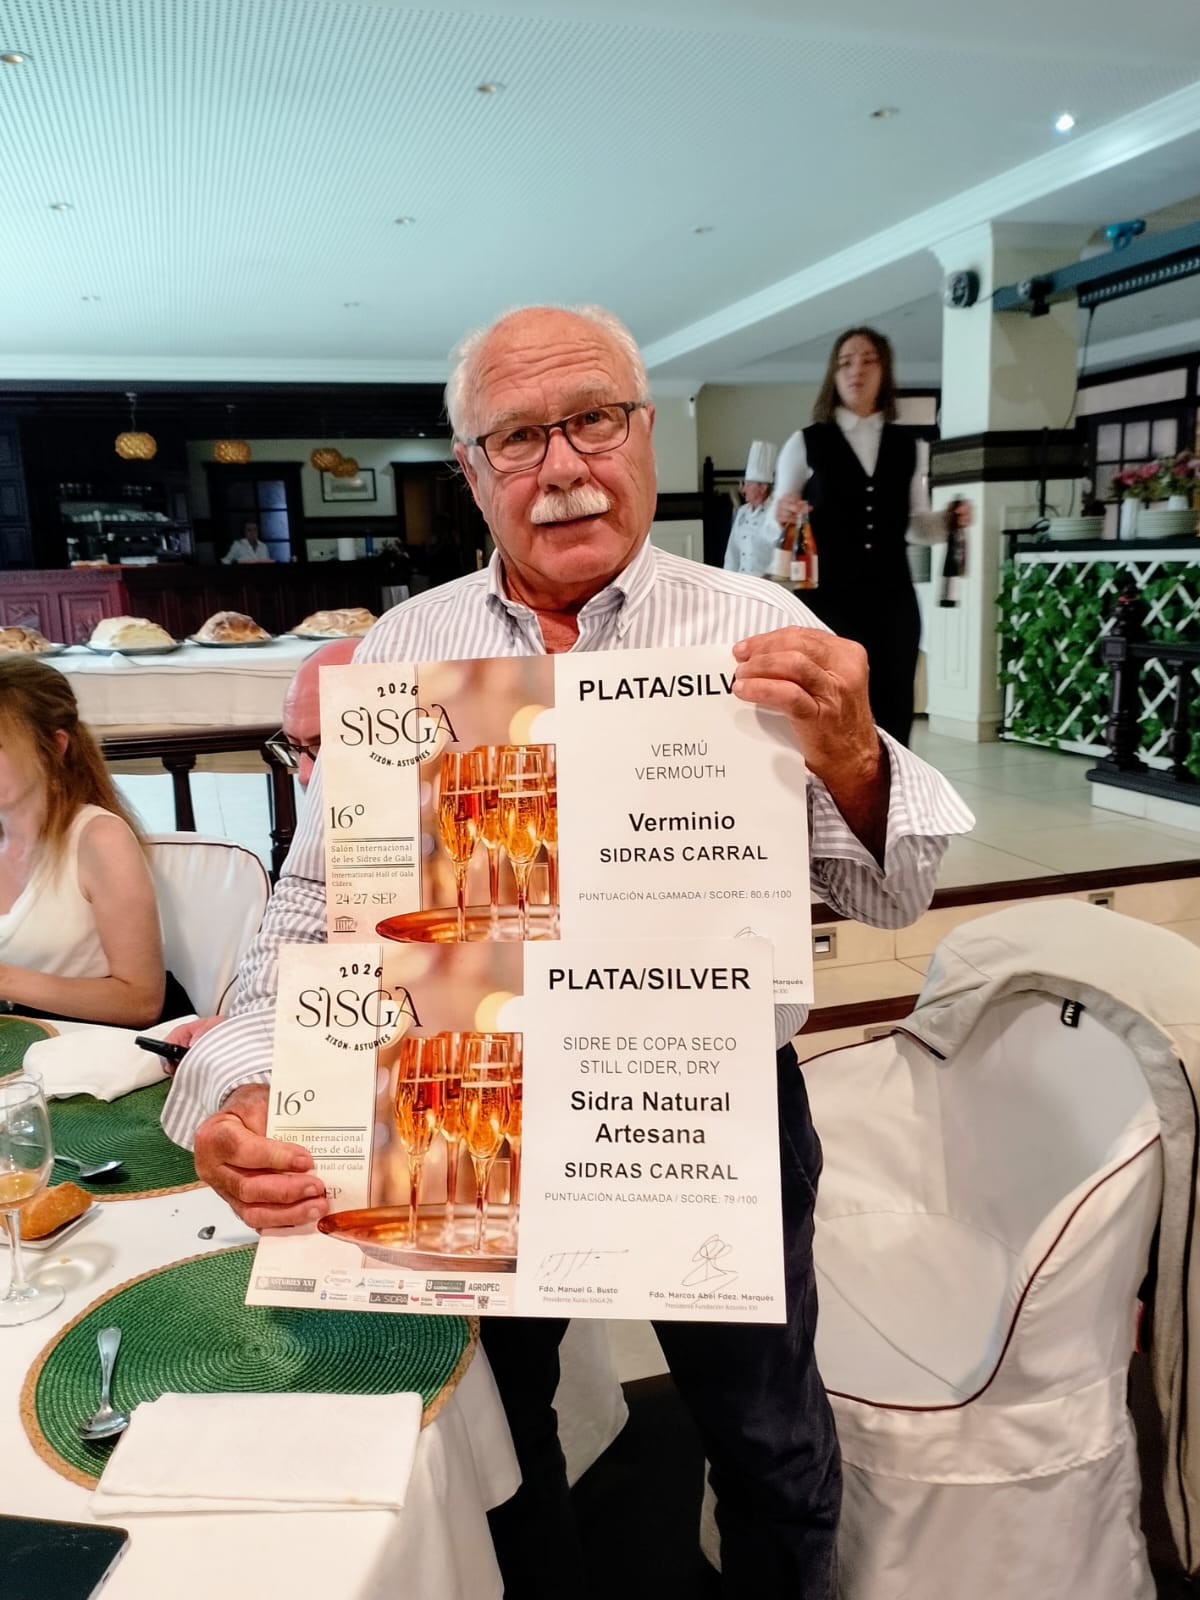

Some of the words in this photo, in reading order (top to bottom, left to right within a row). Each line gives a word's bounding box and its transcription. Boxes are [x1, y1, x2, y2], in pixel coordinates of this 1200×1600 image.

[377, 683, 419, 697] 2026
[579, 671, 736, 702] PLATA/SILV
[340, 703, 460, 746] SISGA
[651, 740, 707, 757] VERMÚ
[635, 765, 725, 780] VERMOUTH
[629, 811, 735, 831] Verminio
[331, 844, 353, 852] Salón
[356, 843, 413, 852] Internacional
[600, 847, 674, 862] SIDRAS
[683, 846, 768, 861] CARRAL
[383, 854, 392, 862] de
[395, 854, 413, 862] Gala
[371, 892, 397, 904] SEP
[579, 891, 643, 901] PUNTUACIÓN
[646, 891, 701, 900] ALGAMADA
[709, 891, 748, 899] SCORE:
[772, 890, 791, 898] /100
[340, 964, 383, 978] 2026
[549, 968, 750, 990] PLATA/SILVER
[296, 986, 423, 1028] SISGA
[564, 1037, 611, 1050] SIDRE
[617, 1037, 637, 1050] DE
[644, 1037, 687, 1050] COPA
[692, 1037, 736, 1051] SECO
[581, 1060, 622, 1073] STILL
[627, 1060, 681, 1075] CIDER,
[687, 1061, 720, 1074] DRY
[571, 1091, 632, 1110] Sidra
[643, 1092, 729, 1111] Natural
[301, 1134, 363, 1142] Internacional
[595, 1123, 705, 1143] Artesana
[330, 1145, 340, 1153] de
[344, 1145, 362, 1154] Gala
[565, 1162, 642, 1178] SIDRAS
[650, 1163, 738, 1180] CARRAL
[323, 1187, 342, 1199] EP
[545, 1192, 612, 1201] PUNTUACIÓN
[615, 1193, 672, 1202] ALGAMADA
[724, 1195, 735, 1204] 79
